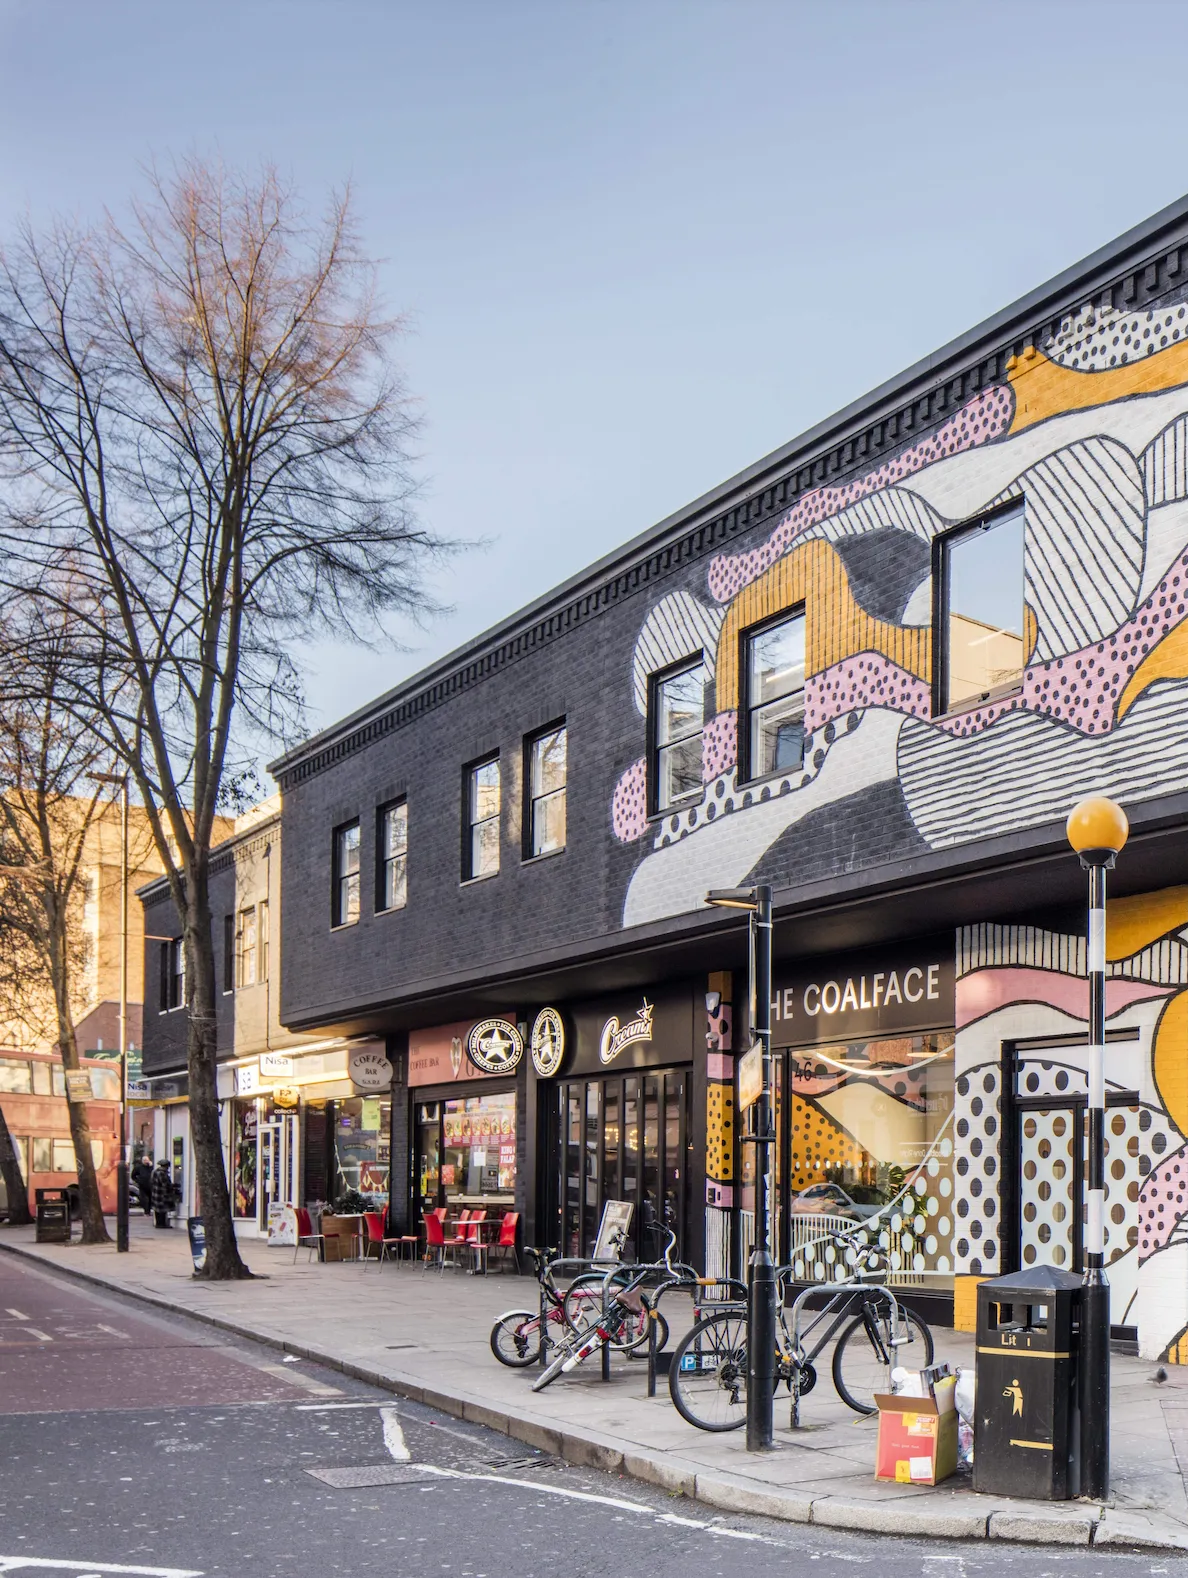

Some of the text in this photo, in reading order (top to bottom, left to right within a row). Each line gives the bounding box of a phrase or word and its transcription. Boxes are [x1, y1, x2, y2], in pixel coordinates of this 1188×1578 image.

[771, 964, 939, 1020] HE COALFACE
[500, 1022, 511, 1033] ICE
[266, 1056, 288, 1065] Nisa
[353, 1054, 390, 1070] COFFEE
[411, 1057, 439, 1070] COFFEE BAR
[794, 1061, 812, 1081] 46
[685, 1356, 694, 1369] P
